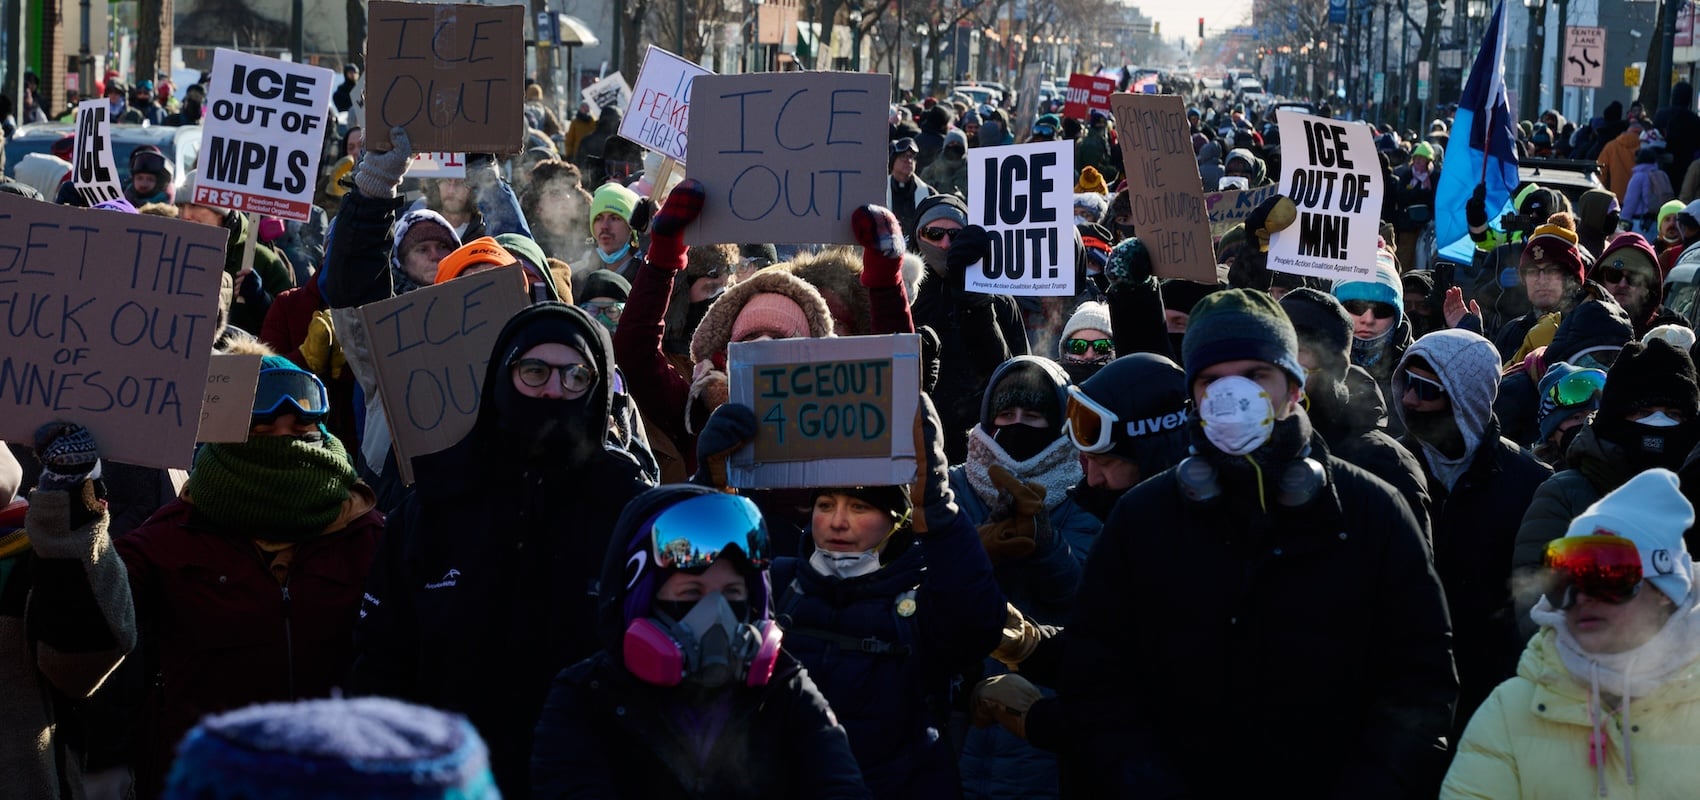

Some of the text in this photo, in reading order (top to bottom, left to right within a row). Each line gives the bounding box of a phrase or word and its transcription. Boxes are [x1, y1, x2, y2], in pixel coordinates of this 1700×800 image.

[380, 18, 502, 63] ICE
[230, 63, 316, 107] ICE
[381, 75, 507, 128] OUT
[1066, 87, 1090, 104] OUR
[212, 99, 320, 135] OUT OF
[638, 88, 689, 133] PEAKE
[718, 88, 869, 155] ICE
[1116, 105, 1190, 155] REMEMBER
[74, 107, 111, 184] ICE
[638, 117, 675, 152] HIGH
[1303, 119, 1354, 170] ICE
[206, 136, 309, 194] MPLS
[1141, 157, 1166, 188] WE
[246, 203, 307, 219] Socialist Organization
[247, 196, 289, 209] Freedom Road
[729, 165, 862, 221] OUT
[984, 152, 1057, 226] ICE
[1288, 168, 1371, 214] OUT OF
[982, 227, 1059, 280] OUT!
[1150, 228, 1199, 265] THEM
[1297, 211, 1350, 260] MN!
[126, 228, 222, 297] THE
[1274, 256, 1370, 275] People's Action Coalition Against Trump
[110, 301, 207, 359] OUT
[375, 281, 495, 358] ICE
[53, 348, 90, 365] OF
[406, 360, 489, 431] OU
[762, 402, 886, 445] 4 GOOD
[1126, 407, 1188, 437] uvex
